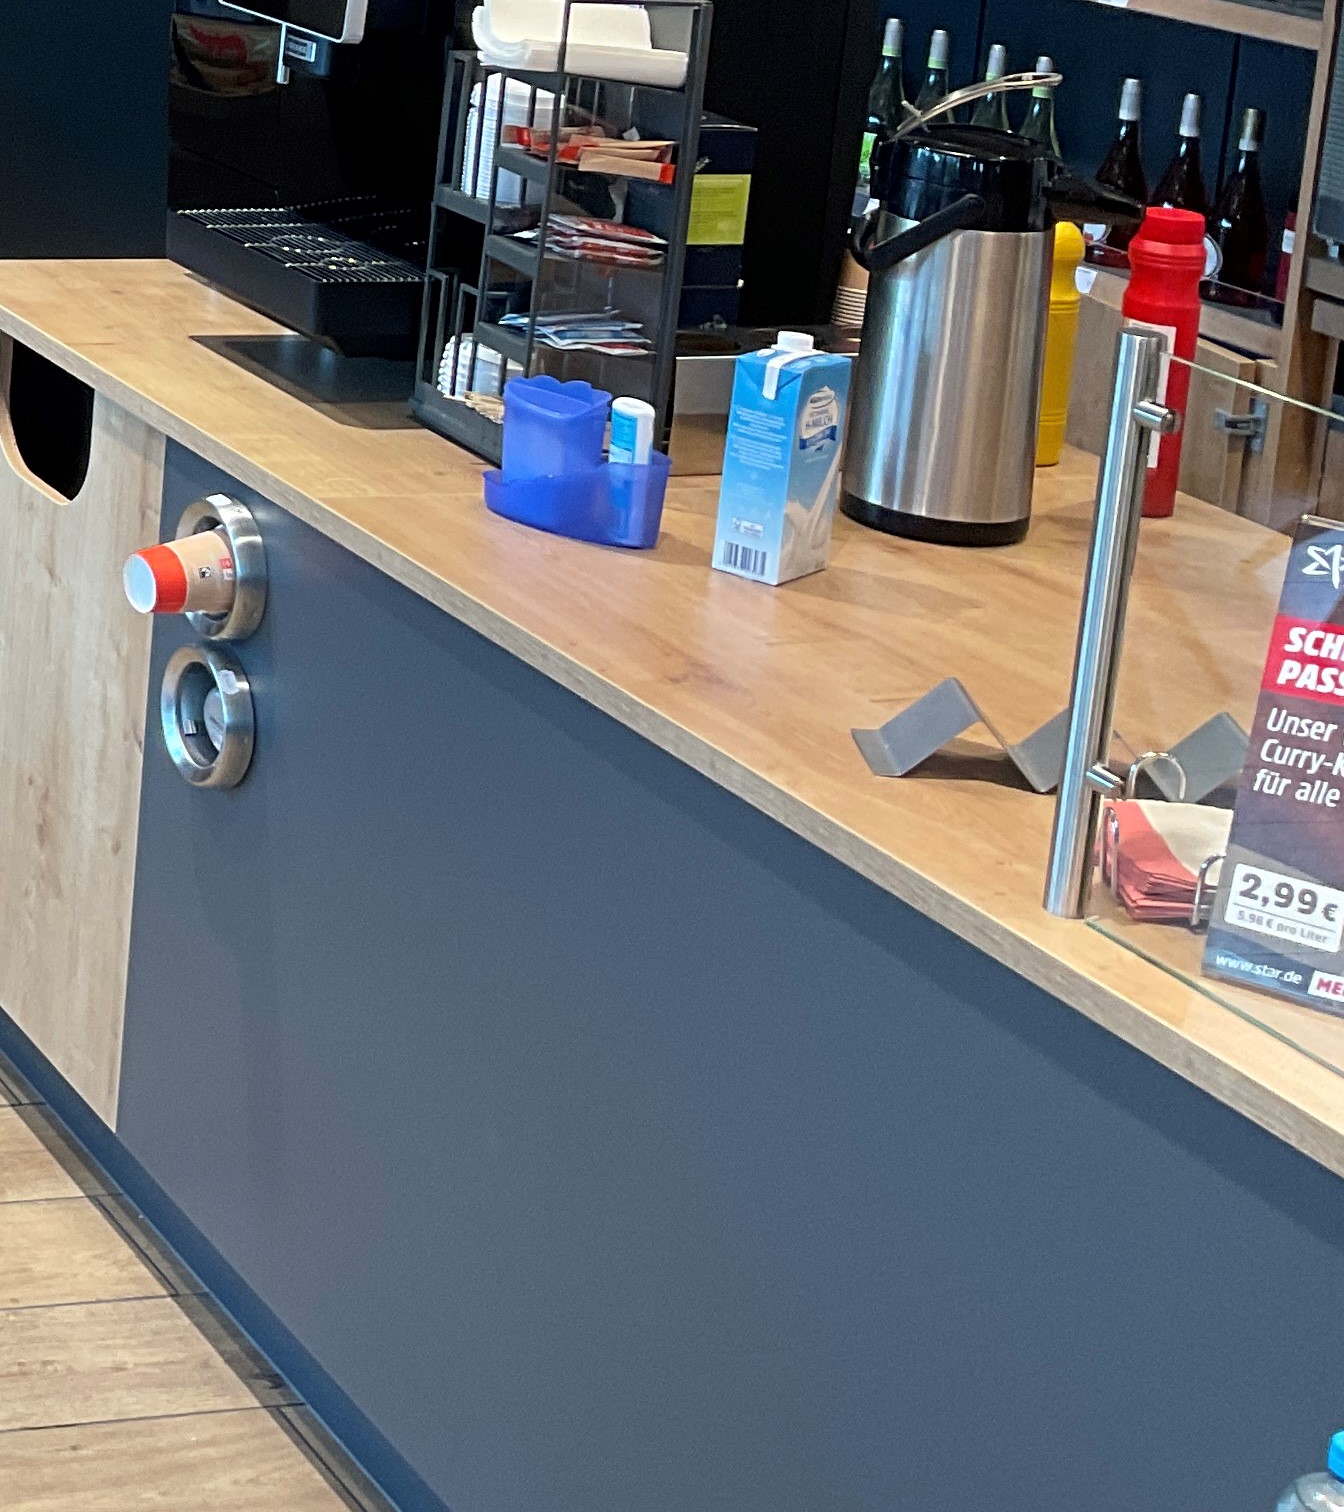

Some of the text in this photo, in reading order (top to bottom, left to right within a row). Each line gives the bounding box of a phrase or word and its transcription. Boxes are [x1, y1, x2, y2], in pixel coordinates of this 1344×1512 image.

[1284, 627, 1344, 662] SCH
[1267, 708, 1339, 742] Unser
[1253, 768, 1341, 808] für alle
[1277, 923, 1298, 935] pro
[1300, 928, 1328, 944] Liter
[1216, 954, 1303, 985] www.star.de
